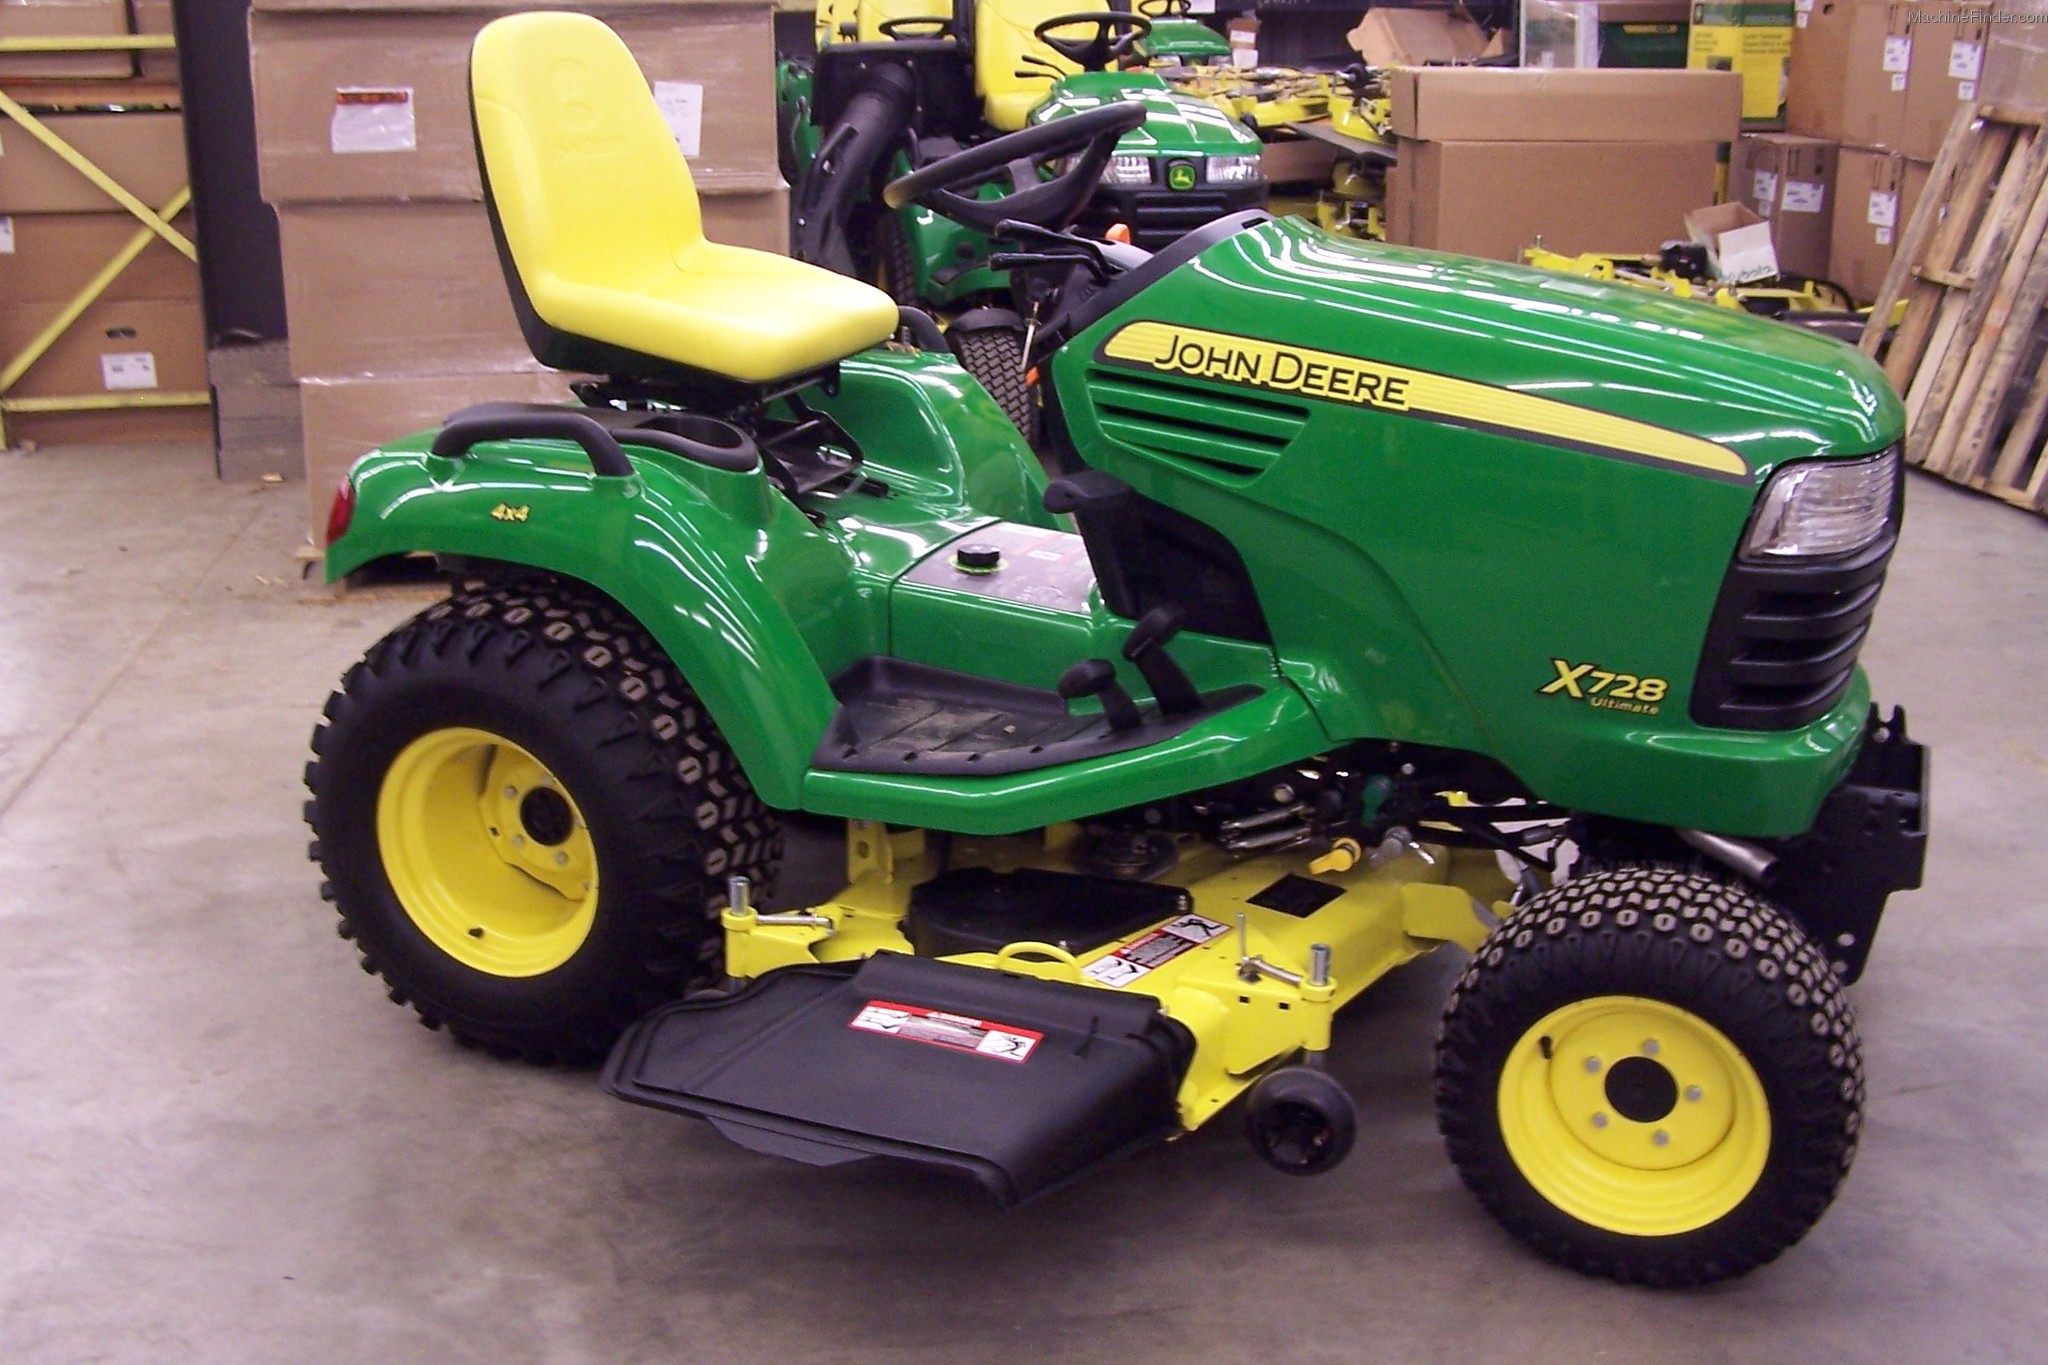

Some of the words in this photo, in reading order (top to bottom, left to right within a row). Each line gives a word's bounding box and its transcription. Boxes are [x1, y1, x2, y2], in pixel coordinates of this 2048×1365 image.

[1154, 334, 1262, 380] JOHN
[1269, 351, 1410, 405] DEERE
[1538, 657, 1669, 703] X728
[1590, 697, 1661, 716] Ultimate
